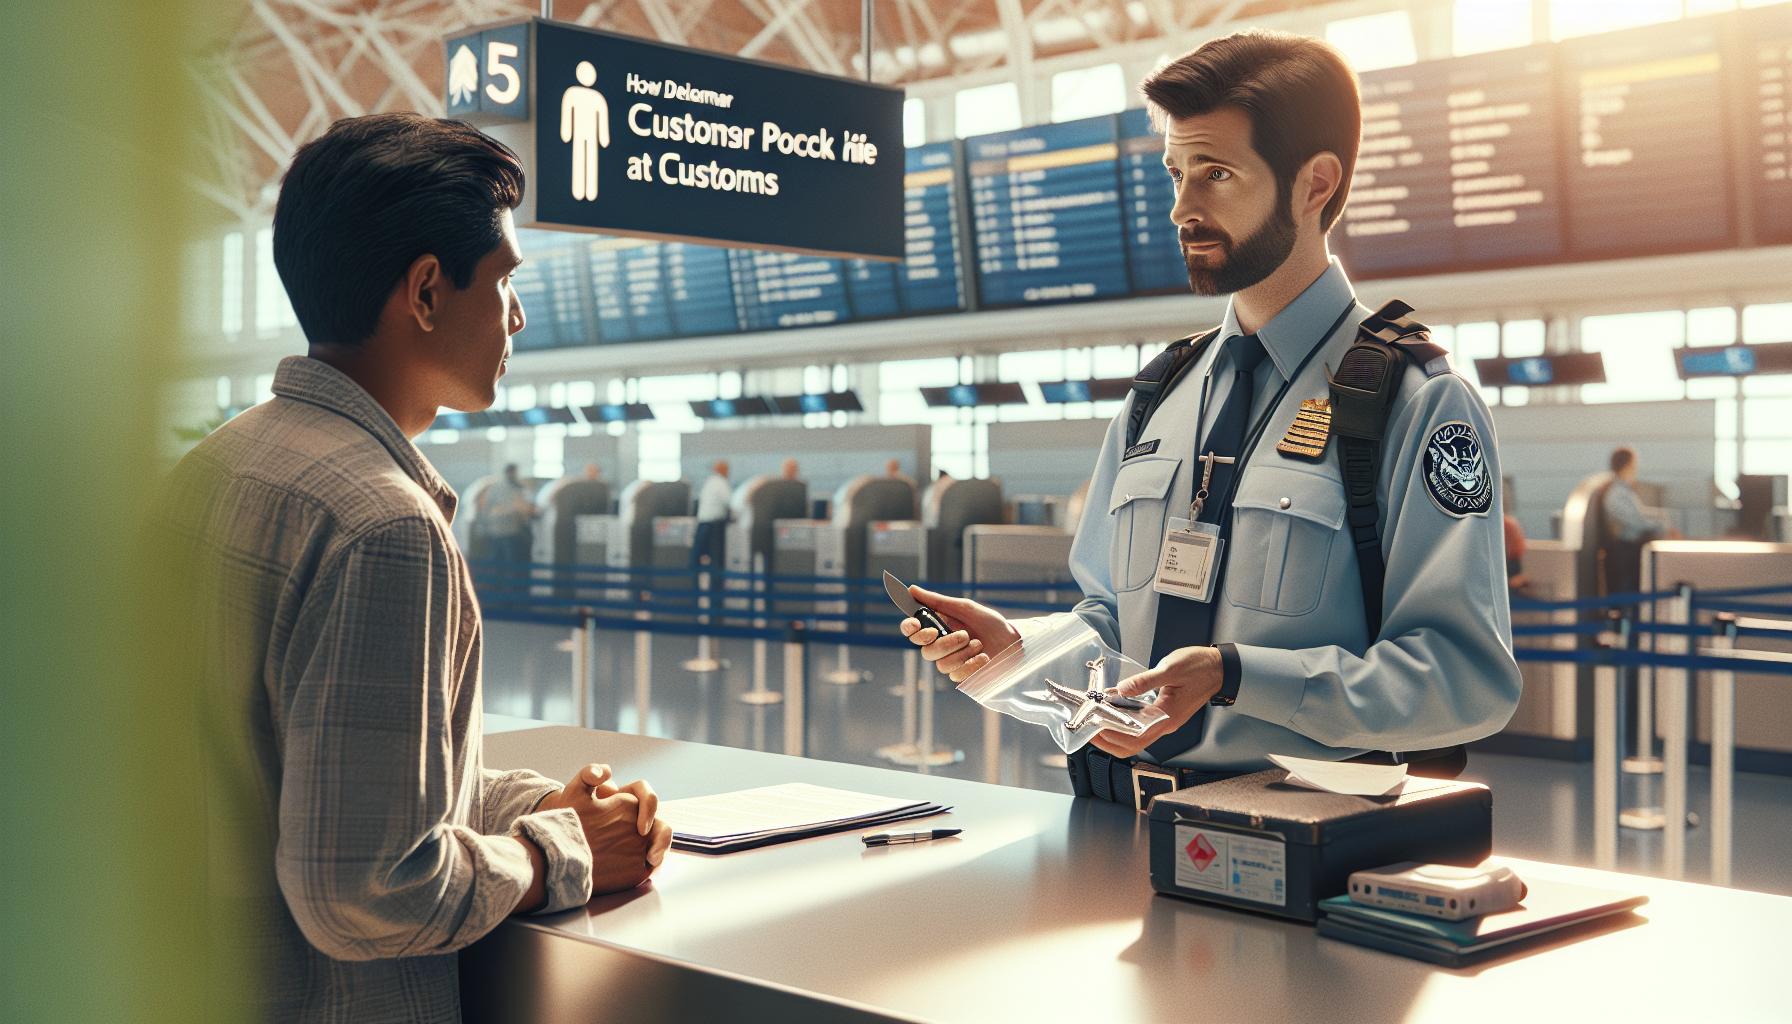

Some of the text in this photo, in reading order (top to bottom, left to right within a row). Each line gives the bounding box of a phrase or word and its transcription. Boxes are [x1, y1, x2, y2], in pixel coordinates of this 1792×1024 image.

[485, 41, 520, 105] 5
[626, 72, 662, 97] How
[626, 152, 779, 196] at Customs
